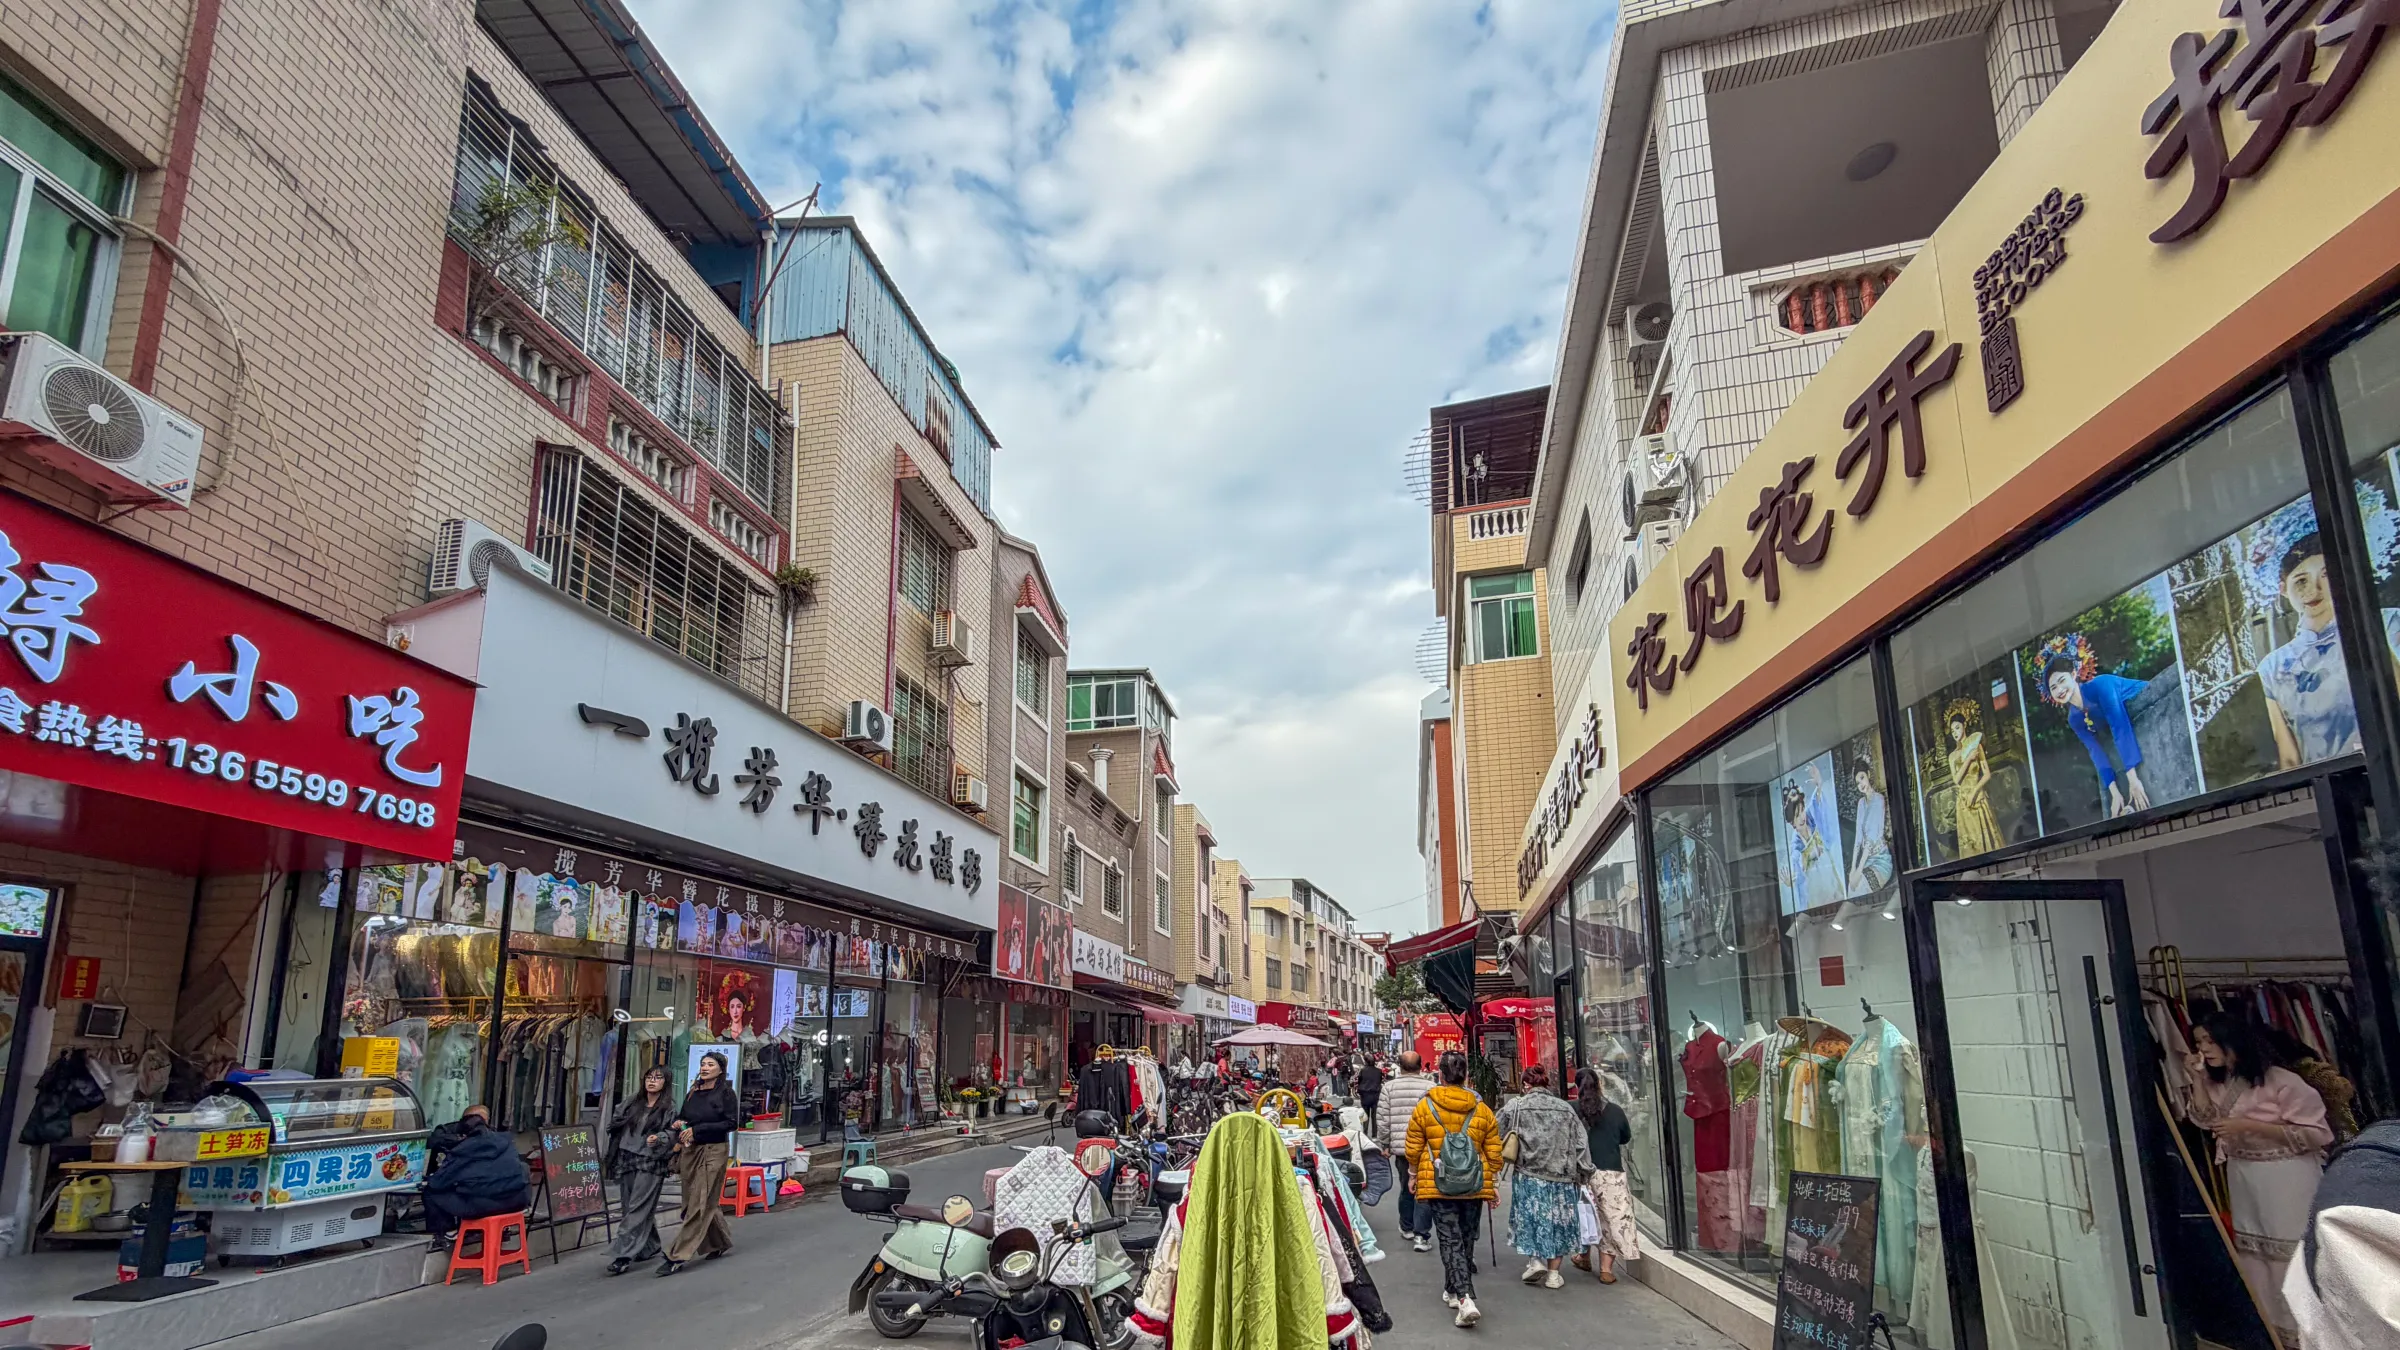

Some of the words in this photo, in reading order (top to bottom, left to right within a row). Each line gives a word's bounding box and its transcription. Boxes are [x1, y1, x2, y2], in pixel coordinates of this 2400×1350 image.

[1972, 187, 2063, 290] SEEING
[1978, 236, 2068, 336] BLOOM
[1626, 329, 1963, 710] 花见花开
[253, 758, 348, 807] 5599
[357, 786, 436, 828] 7698
[503, 847, 786, 918] 一揽芳华簪花摄影
[188, 1166, 259, 1190] 四果汤
[200, 1131, 268, 1155] 土笋冻
[282, 1153, 373, 1190] 四果汤
